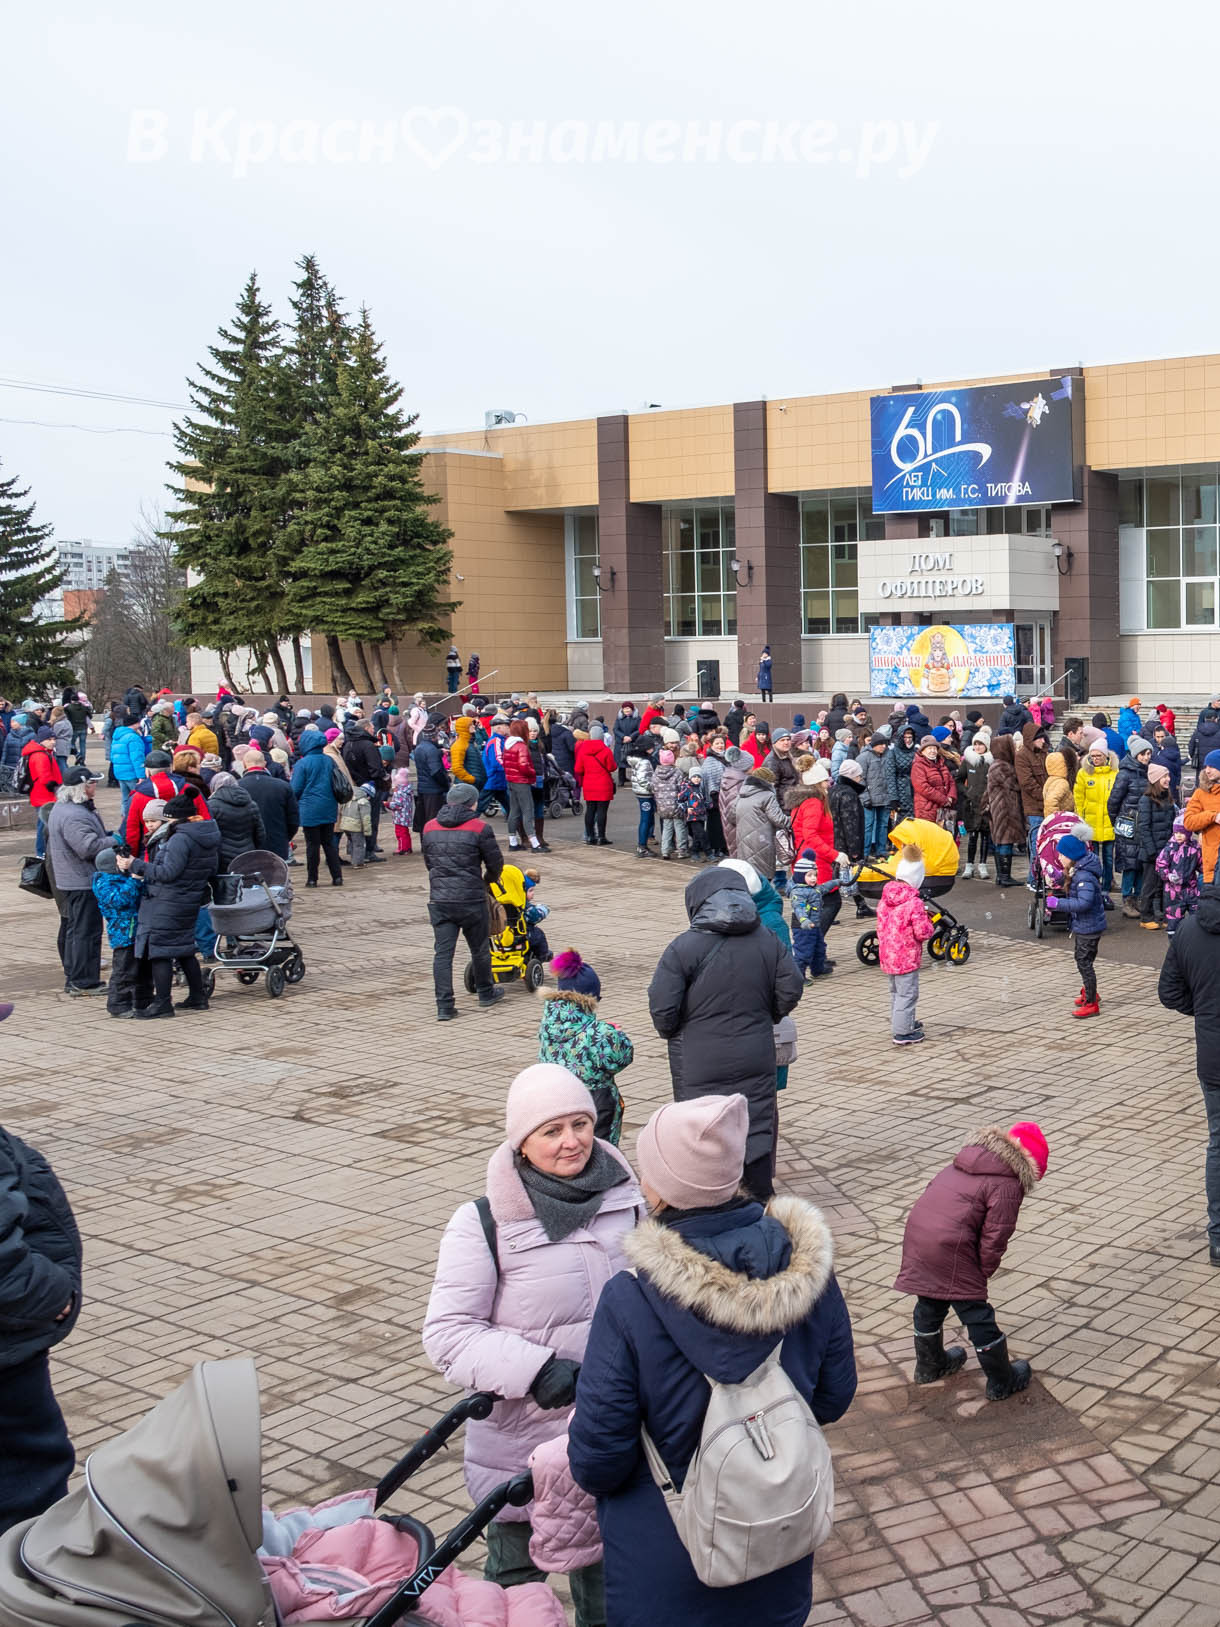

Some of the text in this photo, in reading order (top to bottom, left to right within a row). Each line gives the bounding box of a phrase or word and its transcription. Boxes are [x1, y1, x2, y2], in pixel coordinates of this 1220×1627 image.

[903, 472, 923, 486] ЛЕТ
[986, 481, 1032, 497] ТИТОВА
[908, 552, 953, 575] ДОМ
[878, 578, 984, 601] ОФИЦЕРОВ
[872, 654, 1014, 669] ШИРОКАЯ МАСЛЕНИЦА
